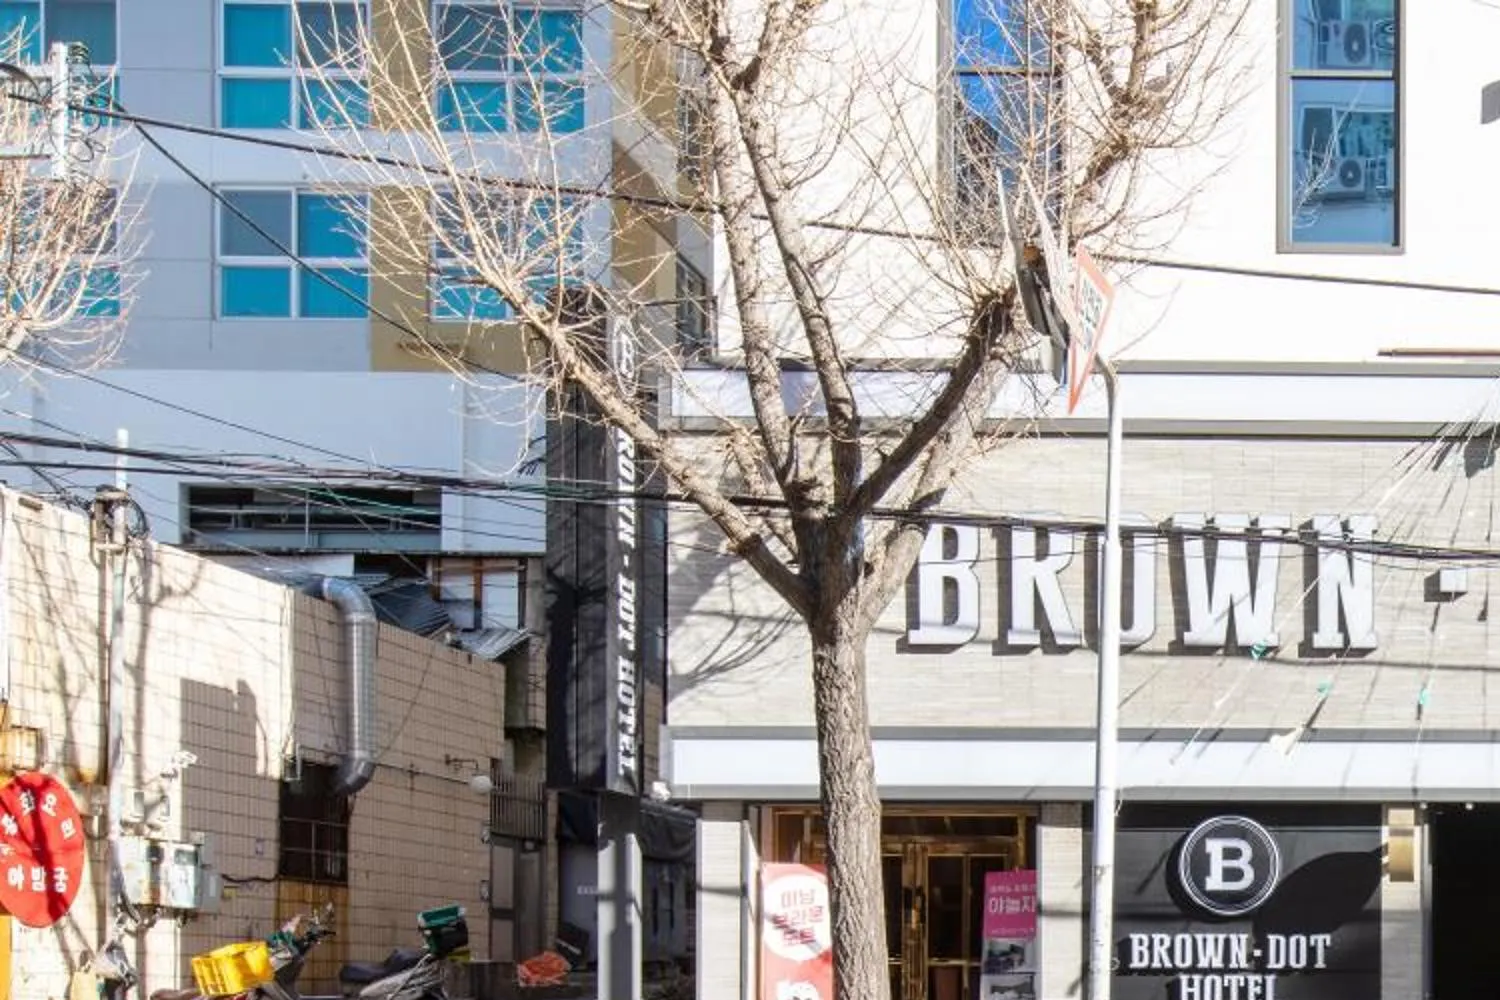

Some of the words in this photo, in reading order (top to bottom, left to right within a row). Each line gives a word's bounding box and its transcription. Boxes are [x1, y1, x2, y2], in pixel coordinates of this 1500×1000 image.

[616, 427, 637, 550] ROWN
[616, 574, 637, 652] DOT
[905, 512, 1378, 652] BROWN
[616, 655, 637, 777] HOTEL
[1204, 836, 1256, 892] B
